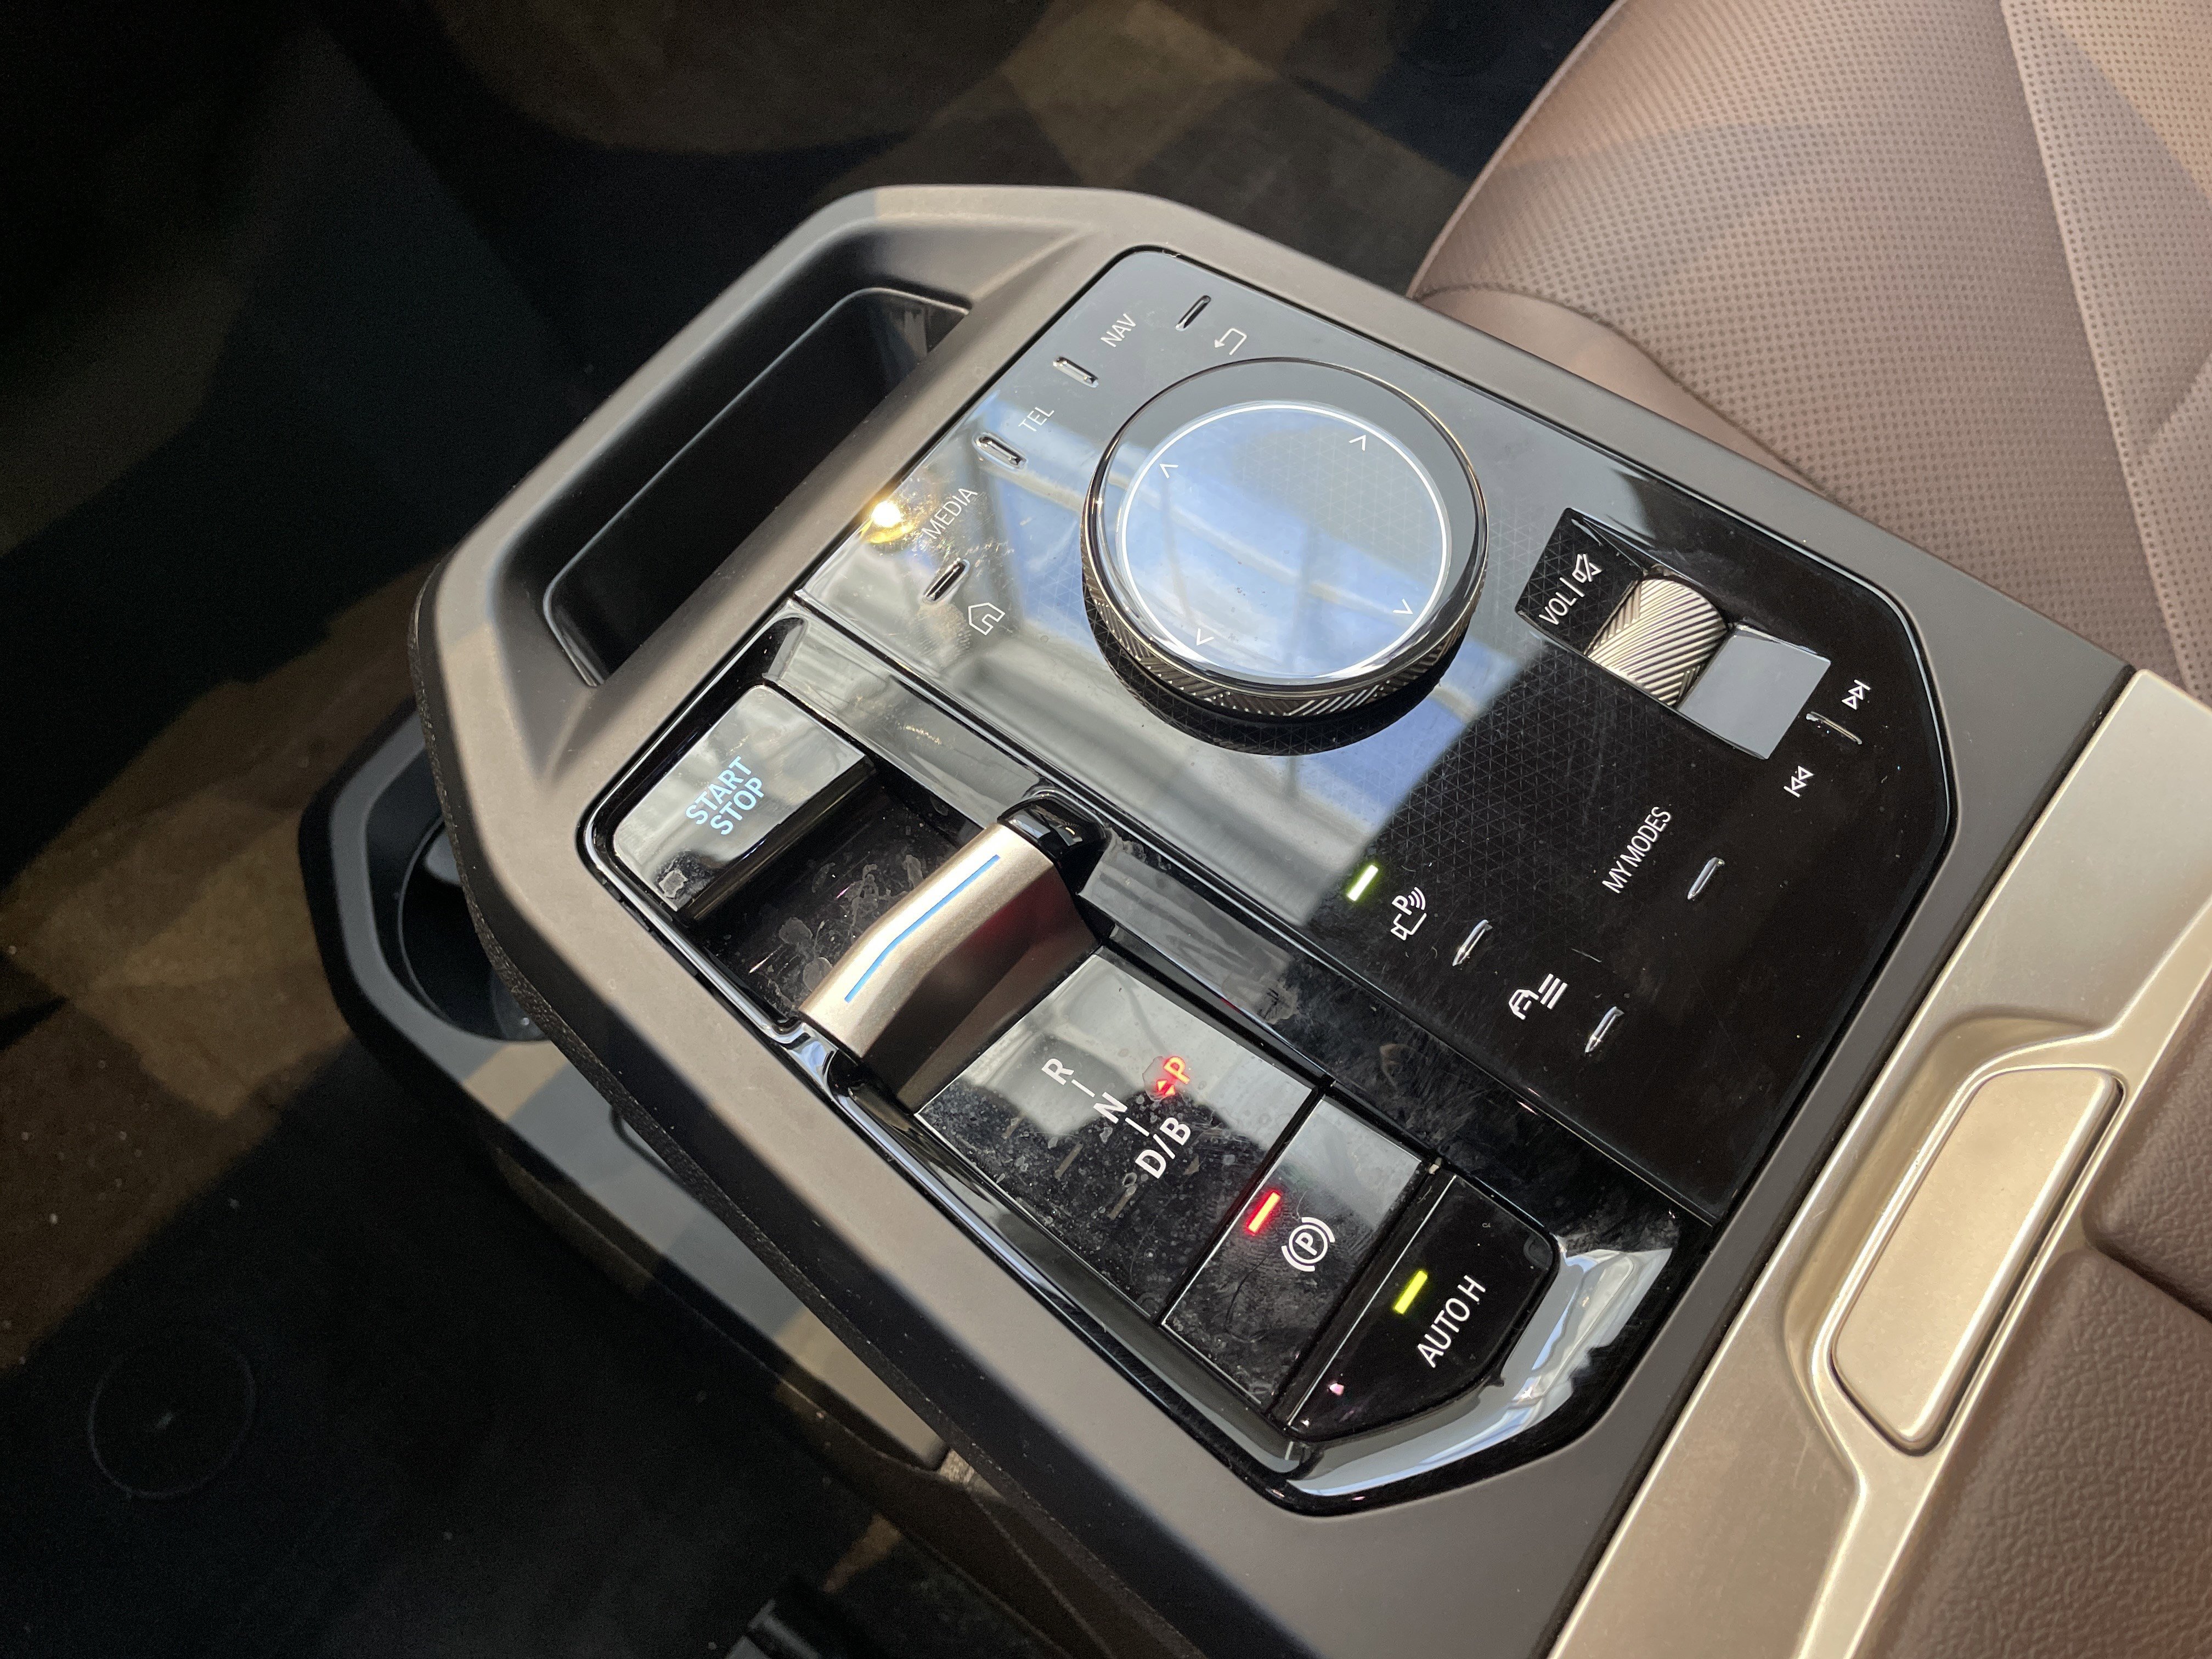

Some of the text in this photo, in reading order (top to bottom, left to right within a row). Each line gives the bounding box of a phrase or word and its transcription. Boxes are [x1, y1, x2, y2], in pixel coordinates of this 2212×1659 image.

[1100, 313, 1137, 347] NAV
[1018, 407, 1054, 432] TEL
[922, 488, 978, 539] MEDIA
[686, 755, 752, 824] START
[710, 777, 764, 836] STOP
[1602, 806, 1671, 894] MY MODES
[1042, 1058, 1074, 1085] R
[1163, 1057, 1190, 1085] P
[1093, 1092, 1127, 1124] N
[1135, 1117, 1191, 1179] D/B
[1295, 1232, 1317, 1256] P
[1417, 1275, 1486, 1368] AUTO H
